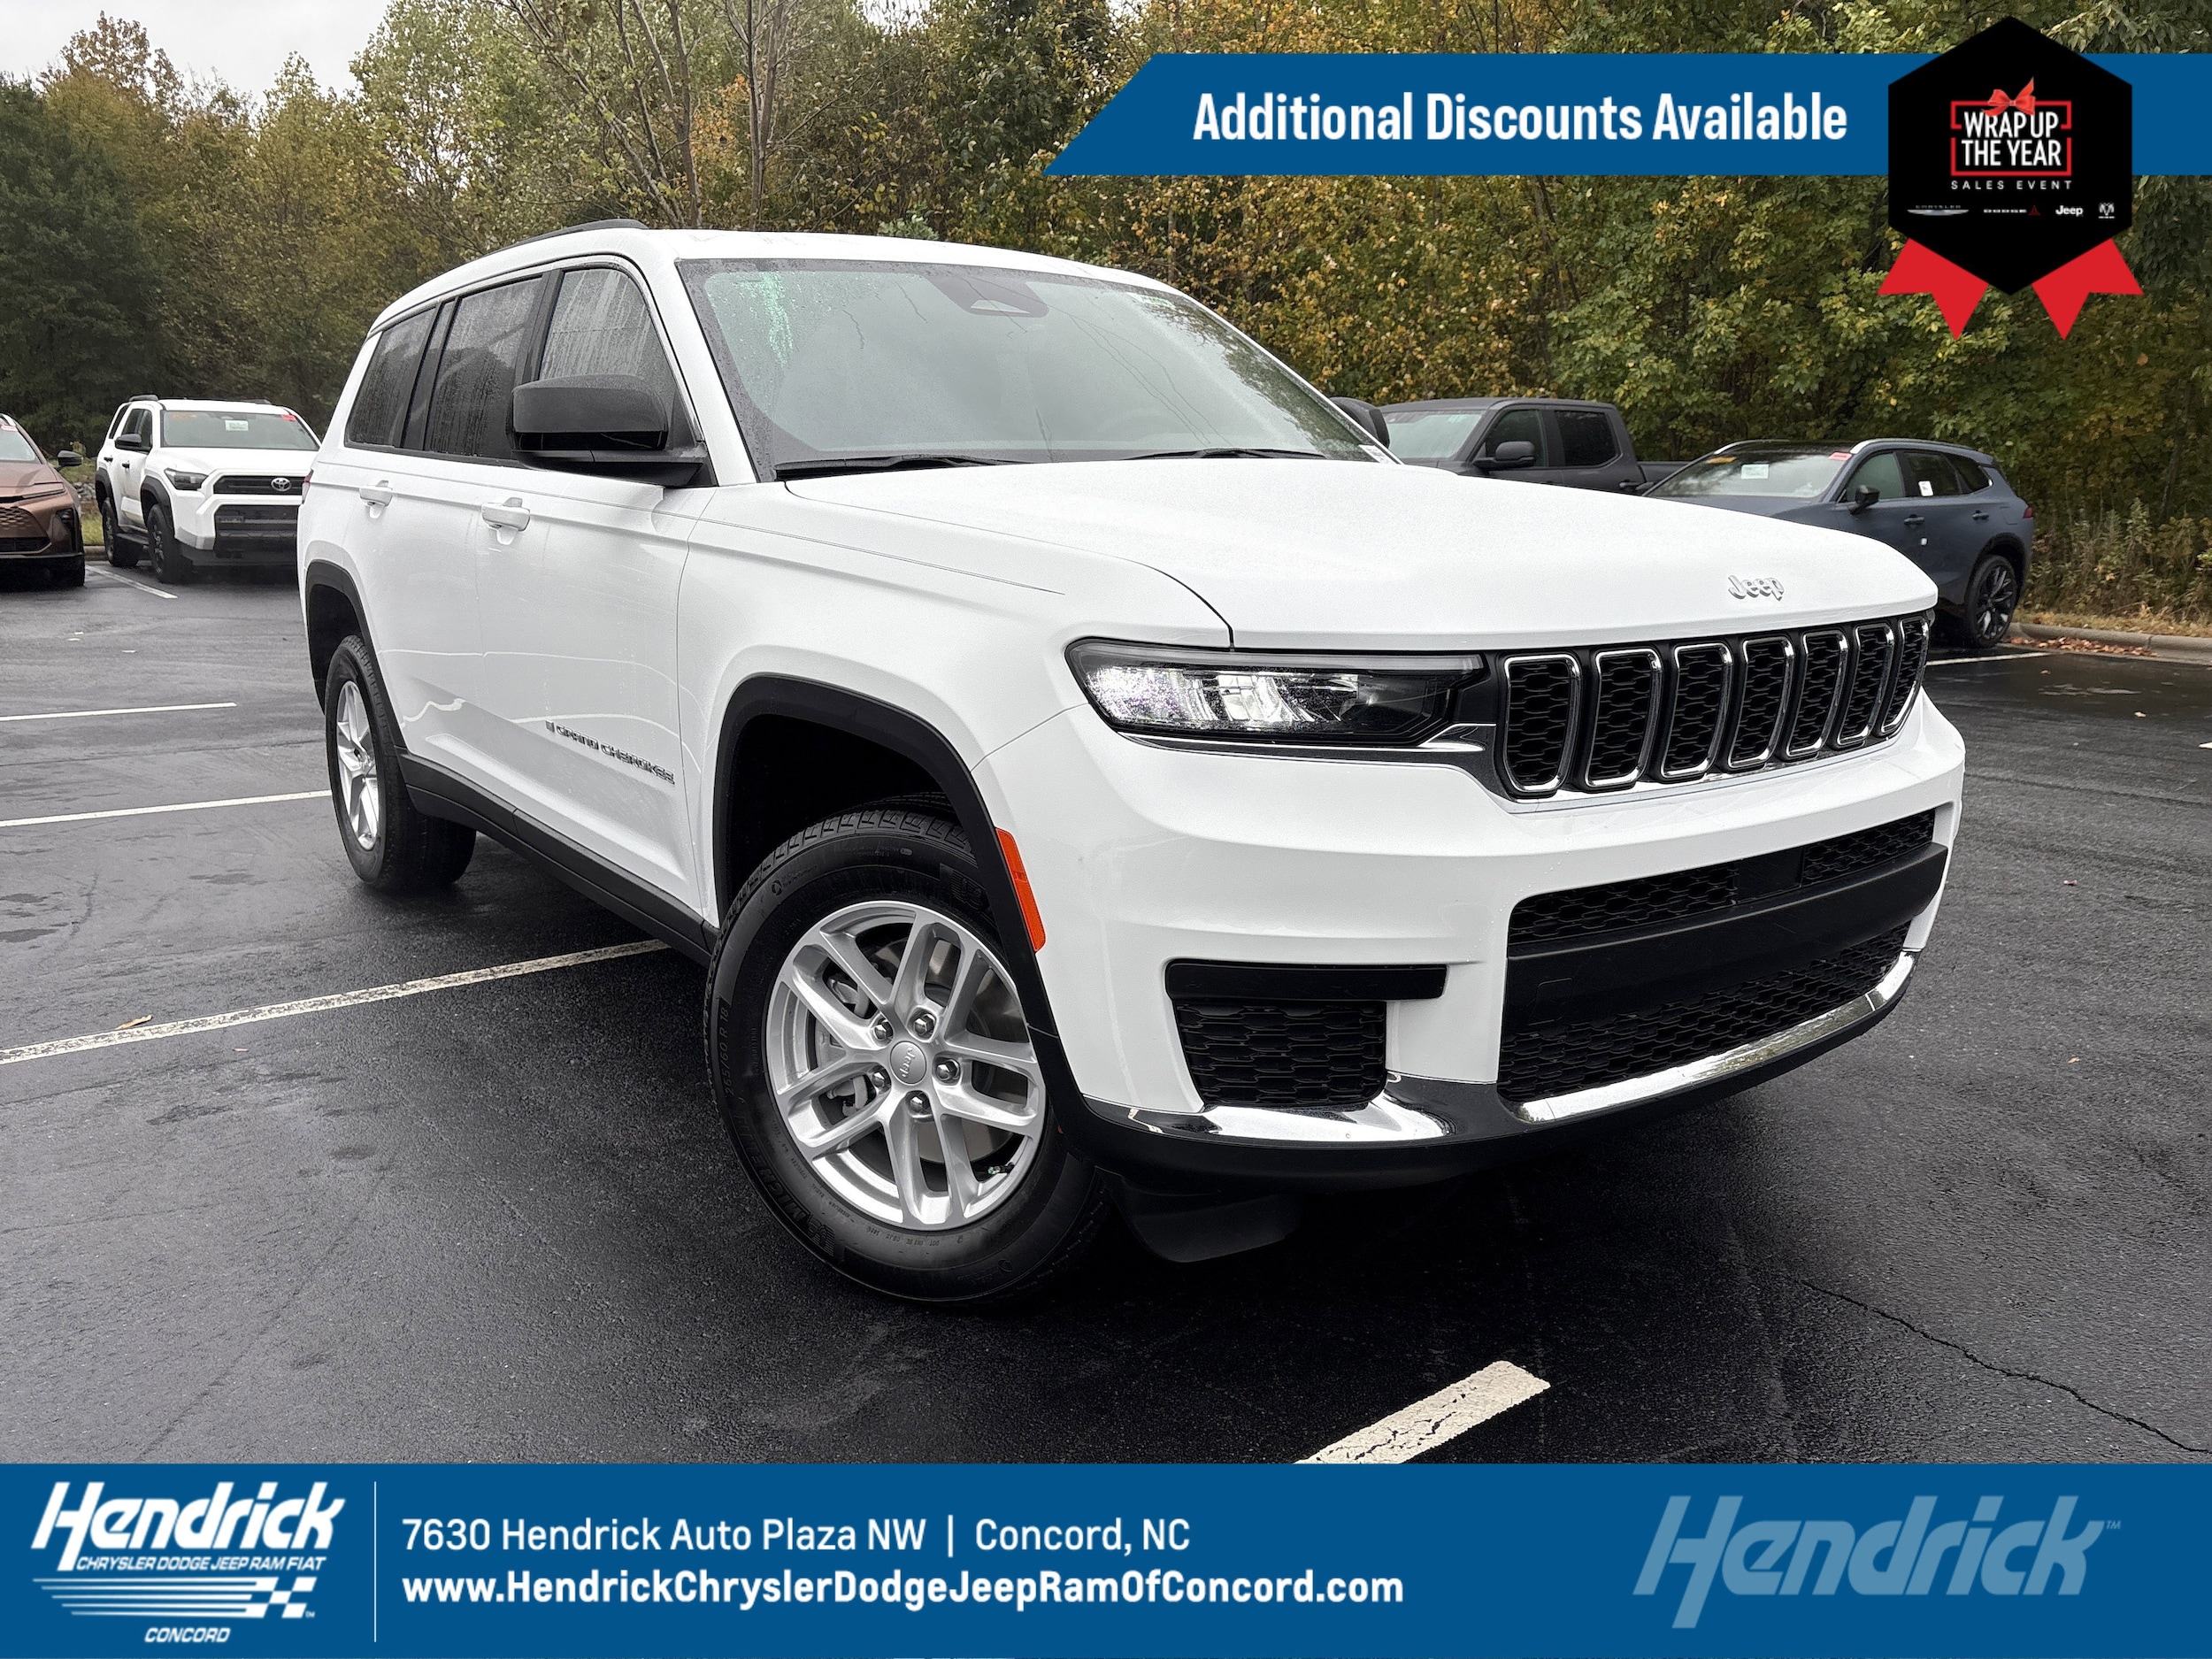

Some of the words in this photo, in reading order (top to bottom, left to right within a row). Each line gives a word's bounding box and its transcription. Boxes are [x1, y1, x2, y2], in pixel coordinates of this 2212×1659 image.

[1728, 575, 1785, 601] Jeep
[556, 726, 599, 750] GRAND
[601, 743, 675, 785] CHEROKEE
[899, 1047, 916, 1078] Jeep
[733, 1114, 809, 1221] MICHELIN
